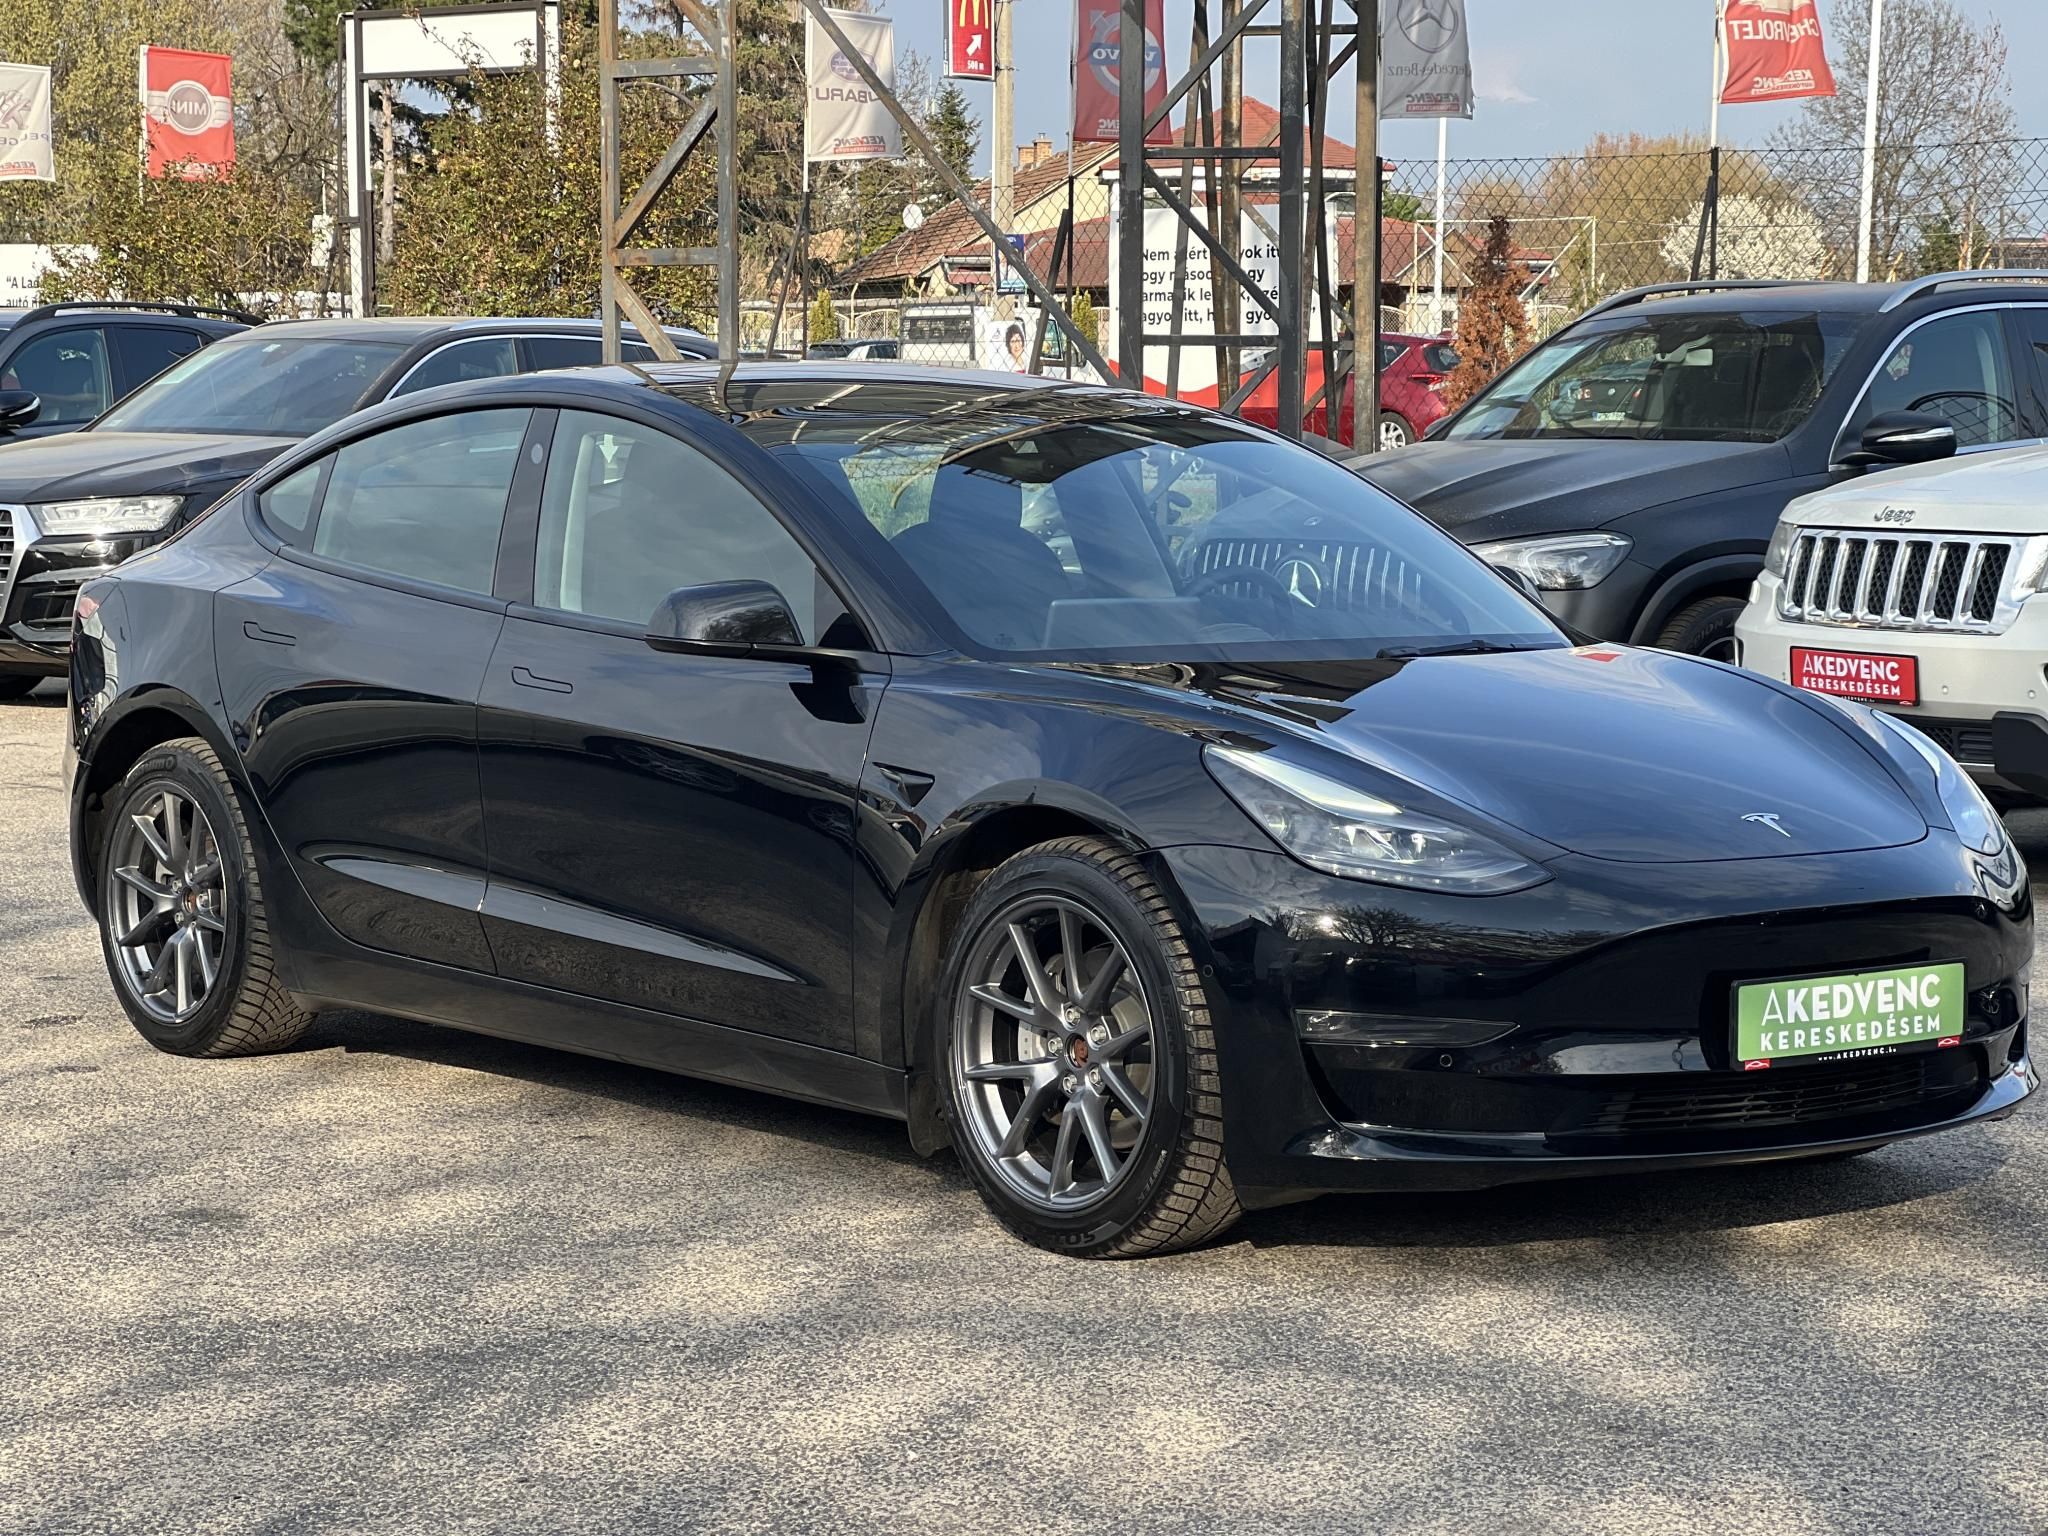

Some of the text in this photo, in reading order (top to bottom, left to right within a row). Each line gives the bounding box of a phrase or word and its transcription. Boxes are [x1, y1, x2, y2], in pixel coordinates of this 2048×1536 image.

[1873, 504, 1917, 527] Jeep
[1802, 653, 1900, 682] AKEDVENC
[1802, 676, 1901, 697] KERESKEDÉSEM
[1761, 973, 1941, 1027] AKEDVENC
[1760, 1012, 1941, 1052] KERESKEDÉSEM
